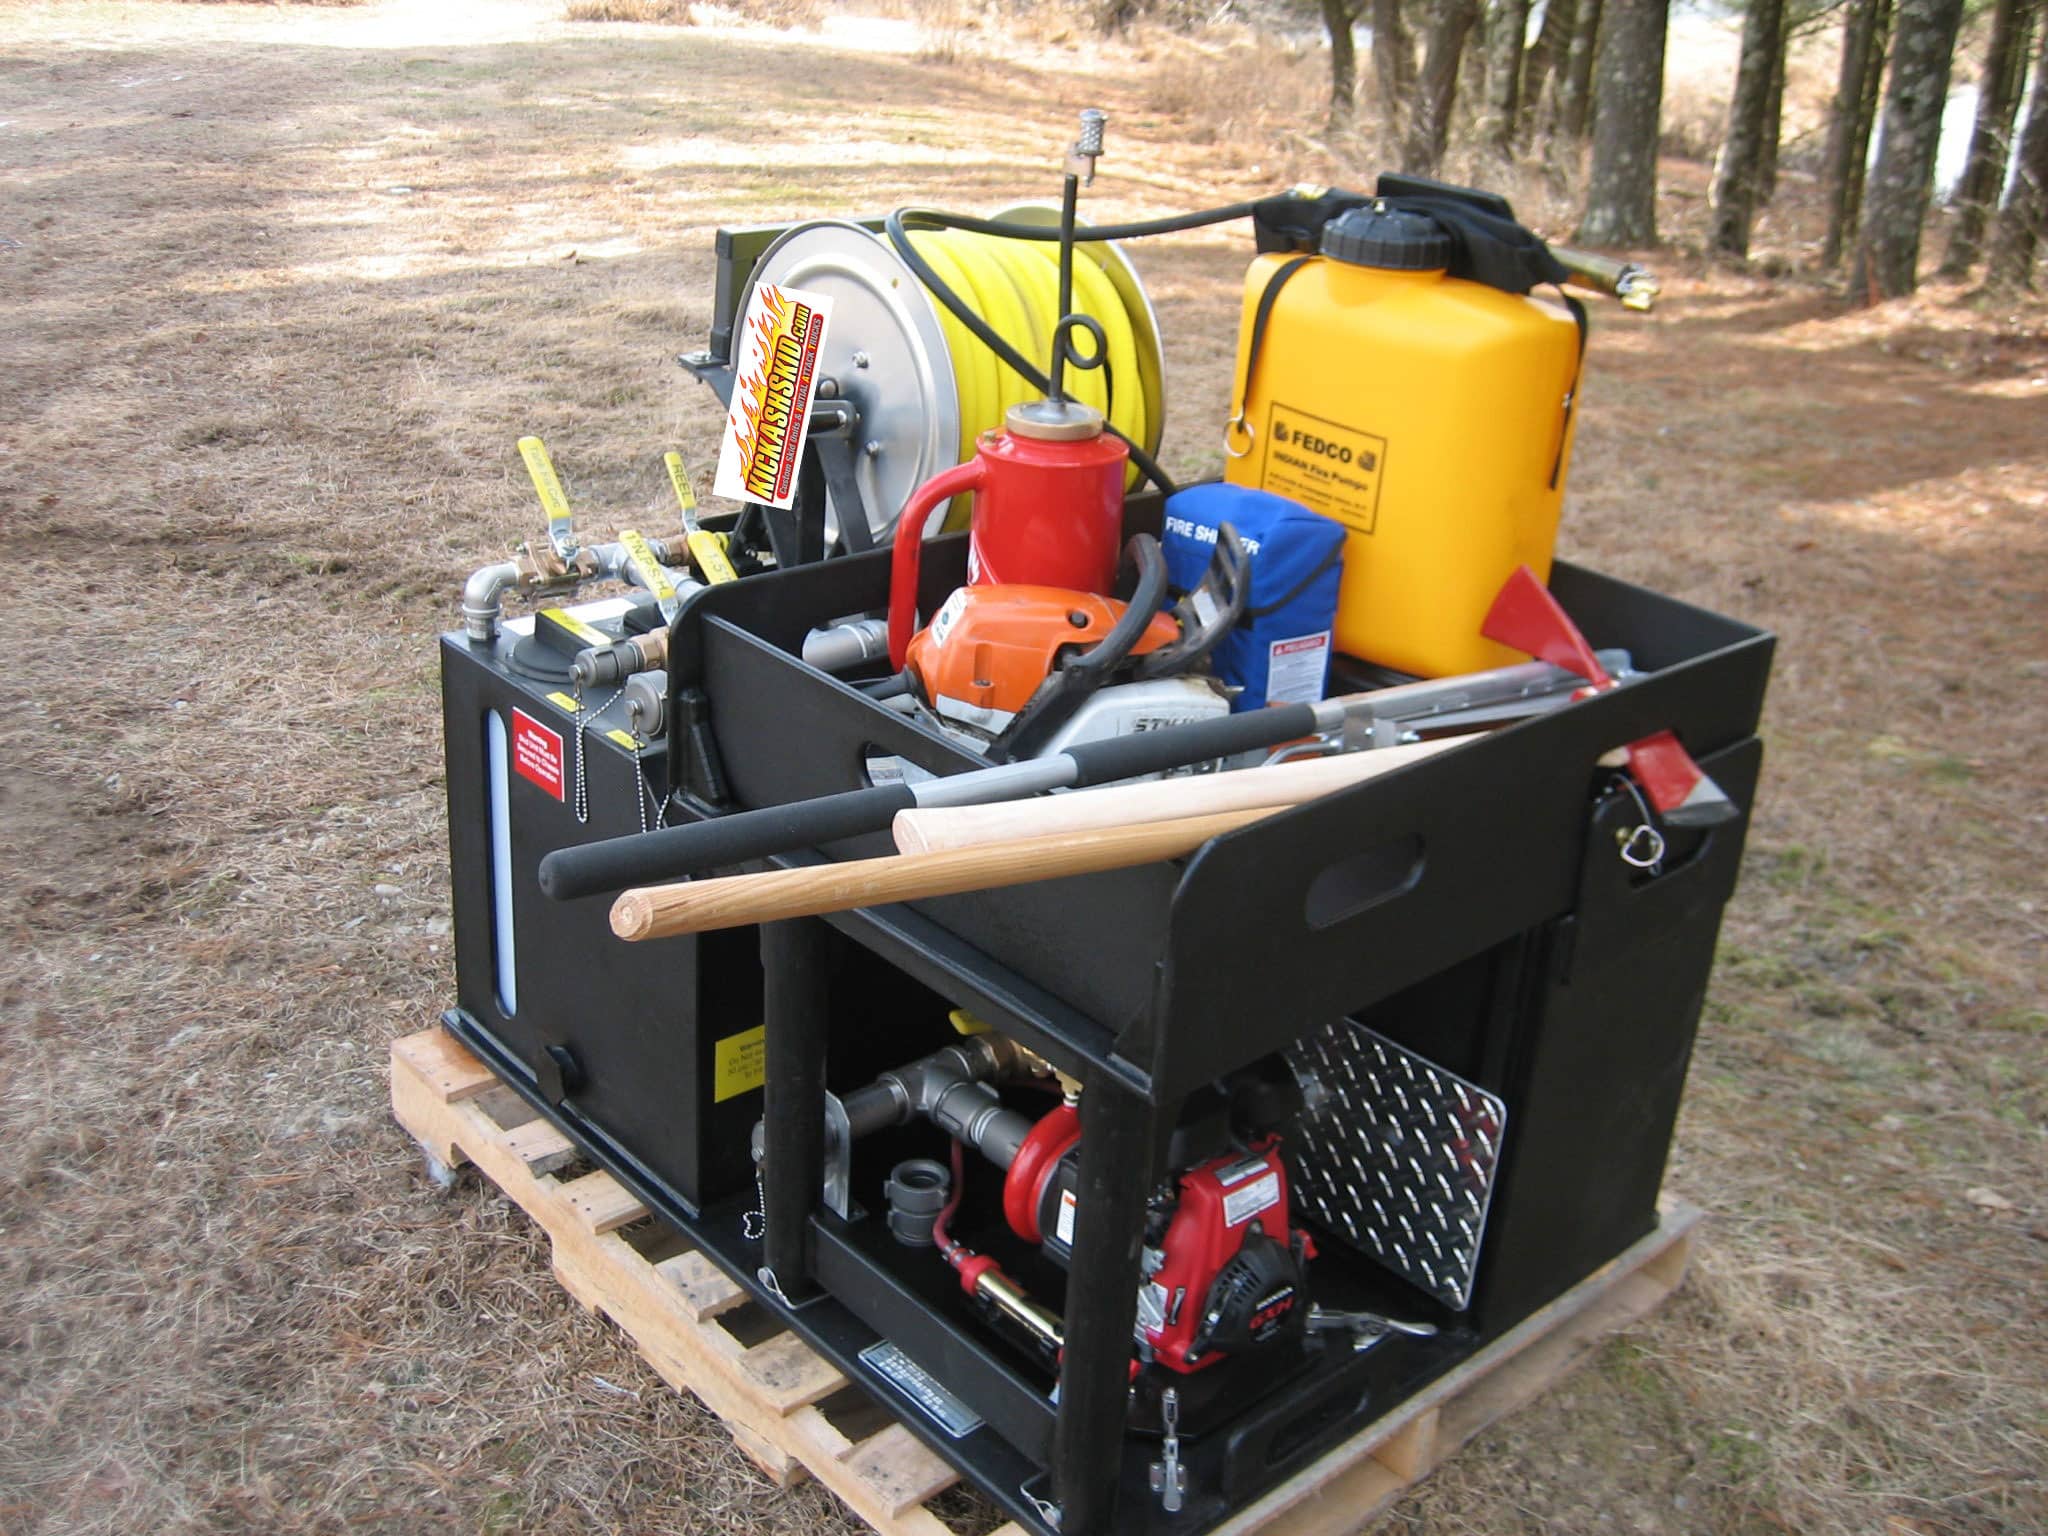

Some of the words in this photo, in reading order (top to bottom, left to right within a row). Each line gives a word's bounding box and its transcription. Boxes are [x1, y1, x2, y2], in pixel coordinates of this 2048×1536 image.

[1291, 429, 1353, 464] FEDCO
[673, 463, 691, 497] REEL
[1166, 517, 1195, 537] FIRE
[1194, 525, 1261, 555] SHER
